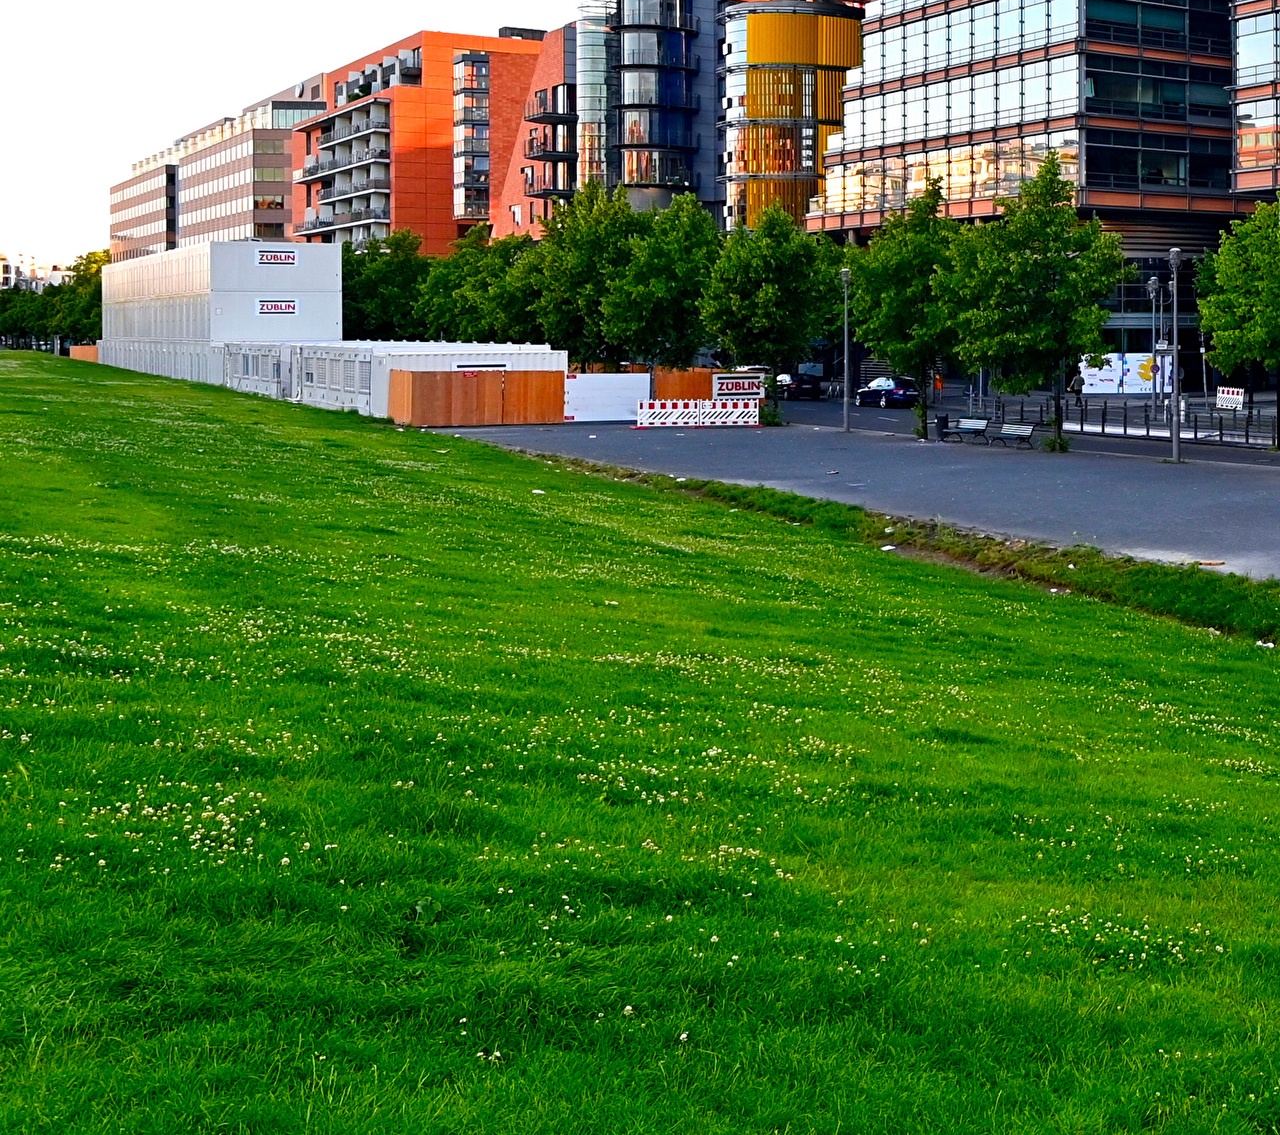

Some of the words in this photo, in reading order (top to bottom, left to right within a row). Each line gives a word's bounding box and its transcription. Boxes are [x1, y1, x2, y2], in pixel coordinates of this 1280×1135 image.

[259, 253, 295, 261] ZÜBLIN
[259, 303, 296, 311] ZÜBLIN
[718, 381, 761, 392] ZÜBLIN
